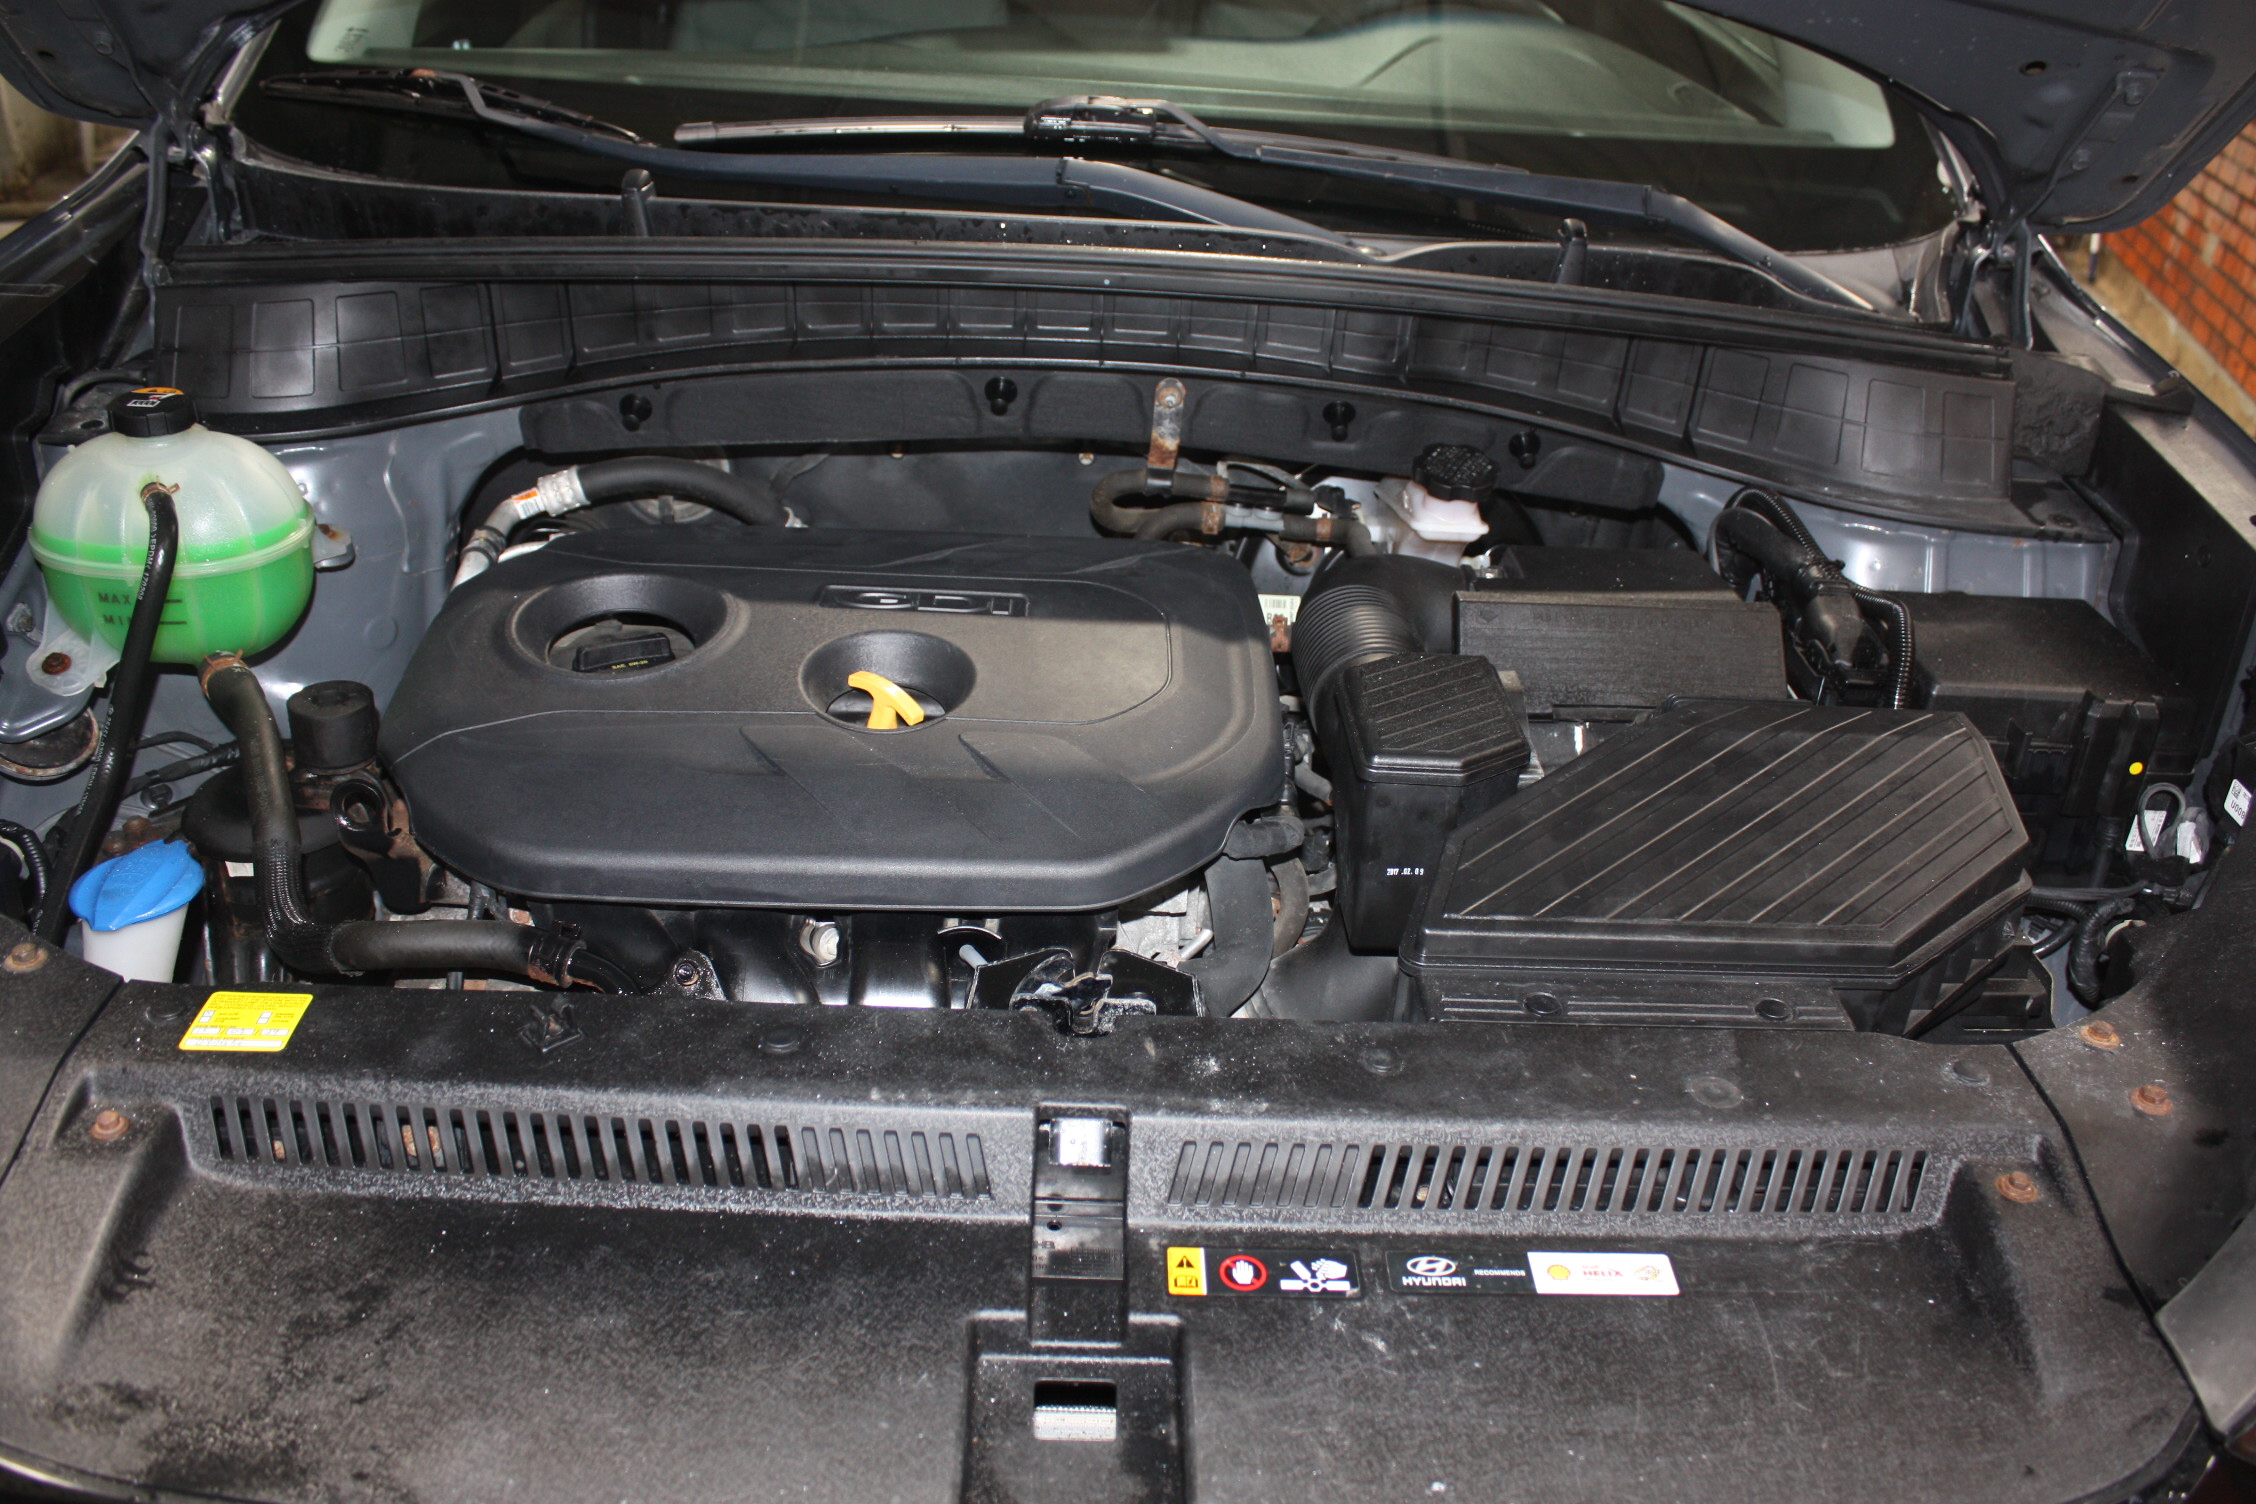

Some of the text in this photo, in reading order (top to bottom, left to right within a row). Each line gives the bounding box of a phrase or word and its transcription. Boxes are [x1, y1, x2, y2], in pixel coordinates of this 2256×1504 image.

[98, 592, 131, 605] MAX
[1402, 1268, 1624, 1287] HYUNDAI RECOMMENDS HELIX
